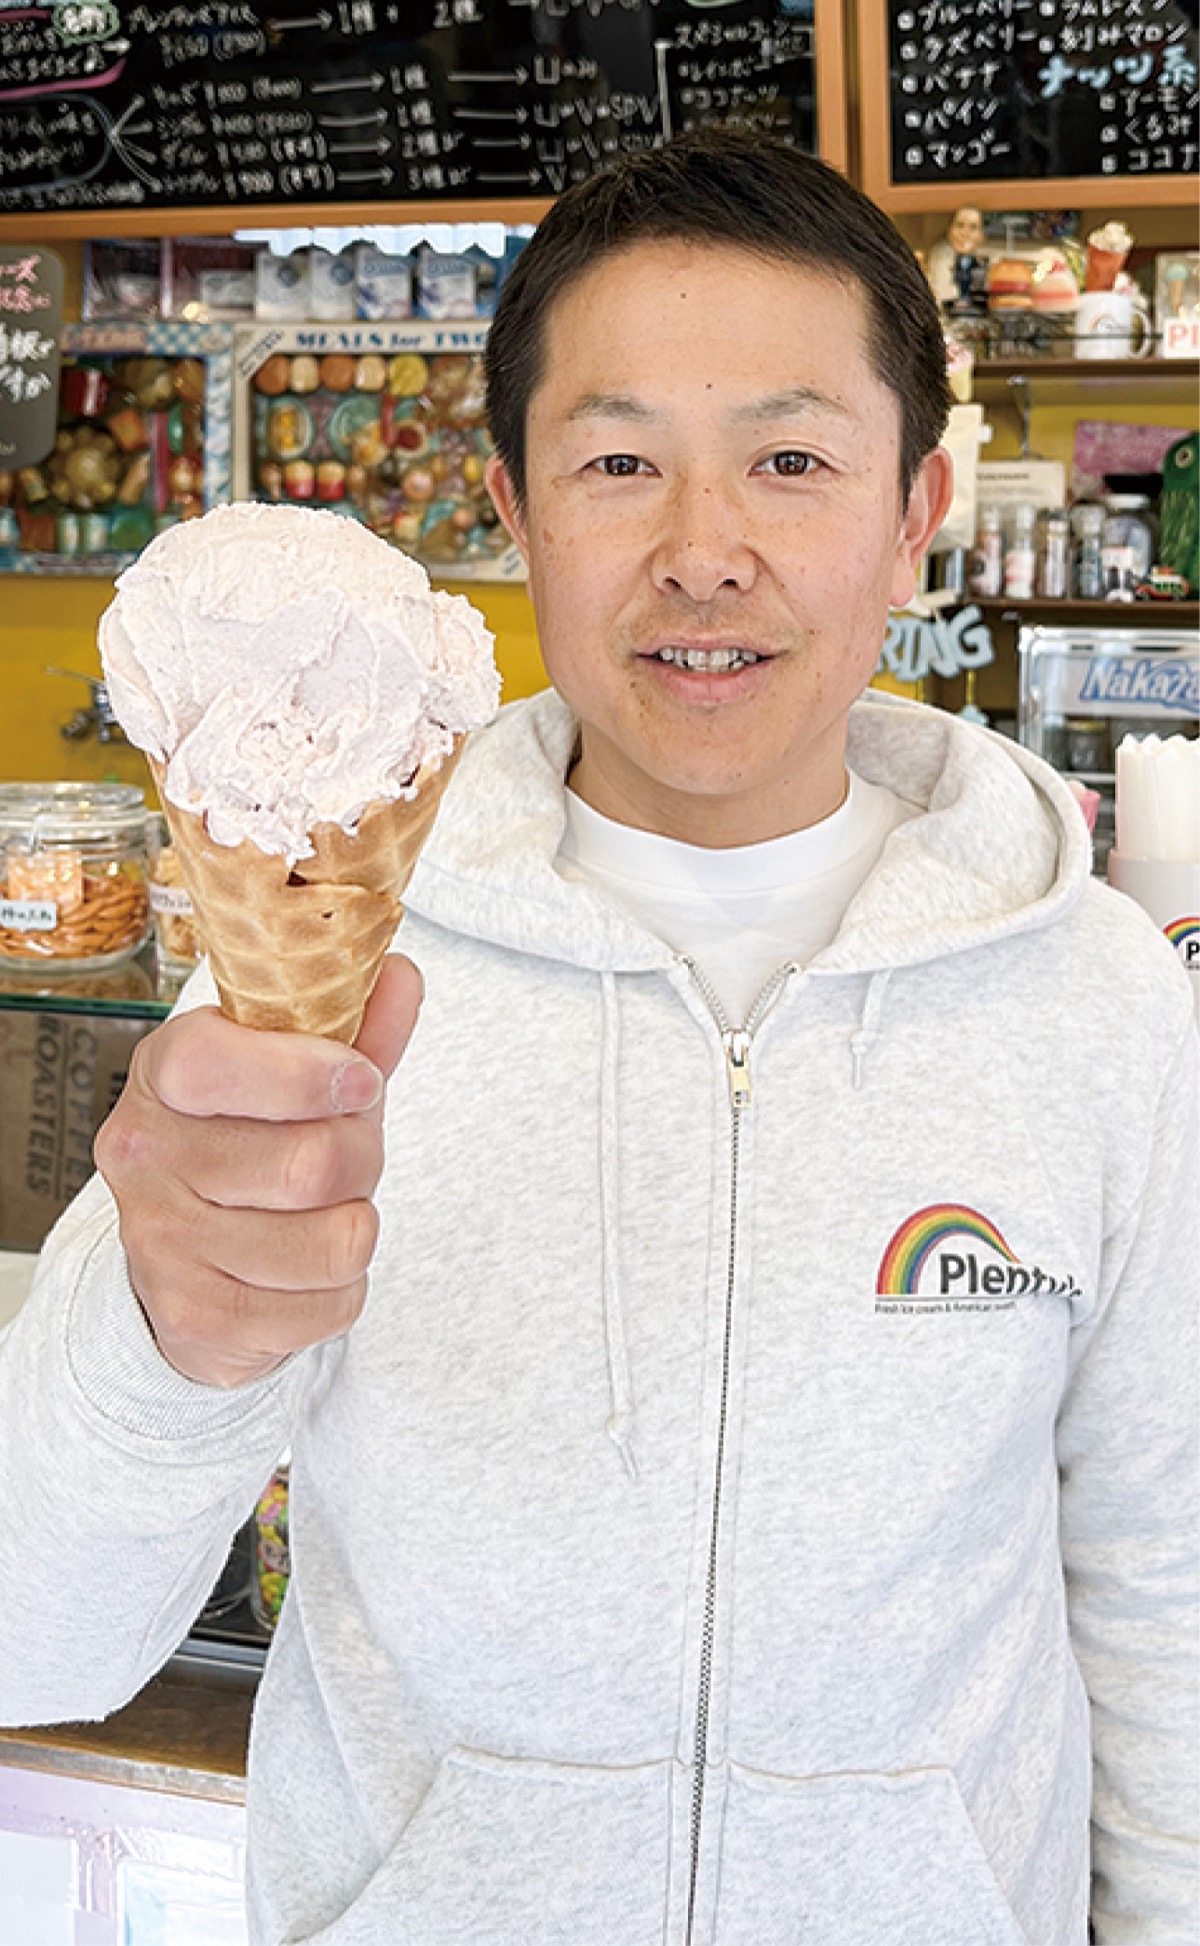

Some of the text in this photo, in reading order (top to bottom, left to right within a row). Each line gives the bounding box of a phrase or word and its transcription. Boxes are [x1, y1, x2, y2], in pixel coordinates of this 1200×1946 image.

[924, 22, 1037, 63] ラズベリー
[923, 60, 1001, 94] バナナ
[1037, 44, 1197, 99] ナッツ系
[924, 97, 1001, 134] パイン
[927, 128, 1012, 169] マンゴー
[296, 331, 383, 347] MEALS
